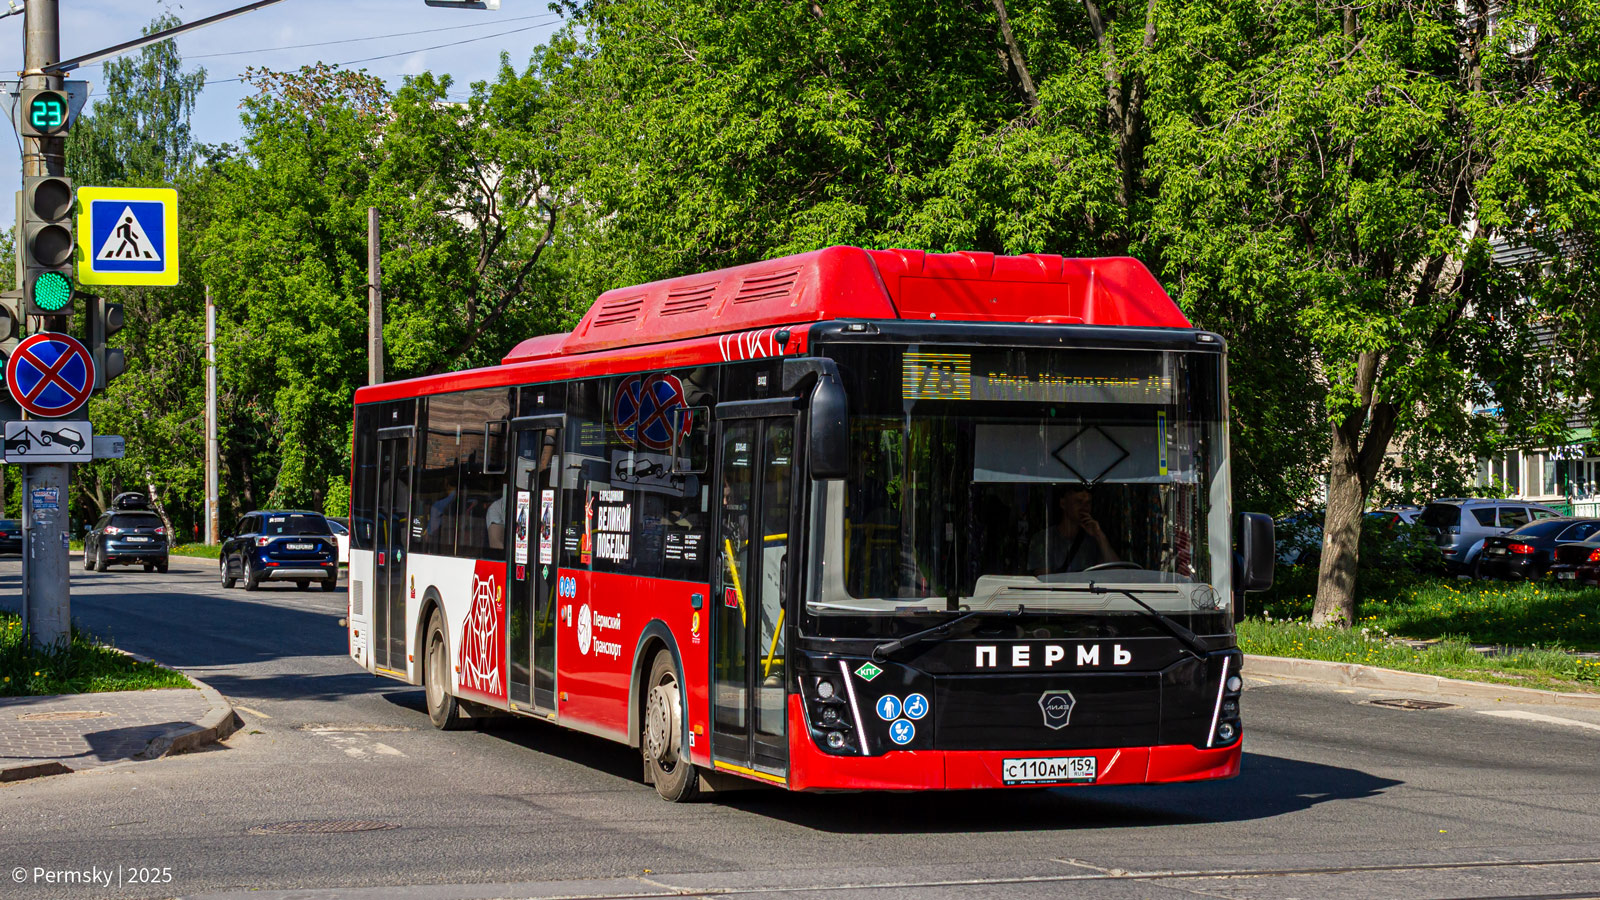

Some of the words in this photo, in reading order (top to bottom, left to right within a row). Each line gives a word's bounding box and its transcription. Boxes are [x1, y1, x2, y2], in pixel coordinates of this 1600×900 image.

[32, 101, 61, 126] 23
[598, 503, 631, 532] ВЕЛИКОЙ
[596, 533, 630, 563] ПОБЕДЫ!
[593, 610, 621, 632] Пермский
[592, 636, 622, 661] Транспорт
[975, 644, 1132, 667] ПЕРМЬ
[860, 668, 877, 676] КПГ
[1070, 759, 1092, 771] 159
